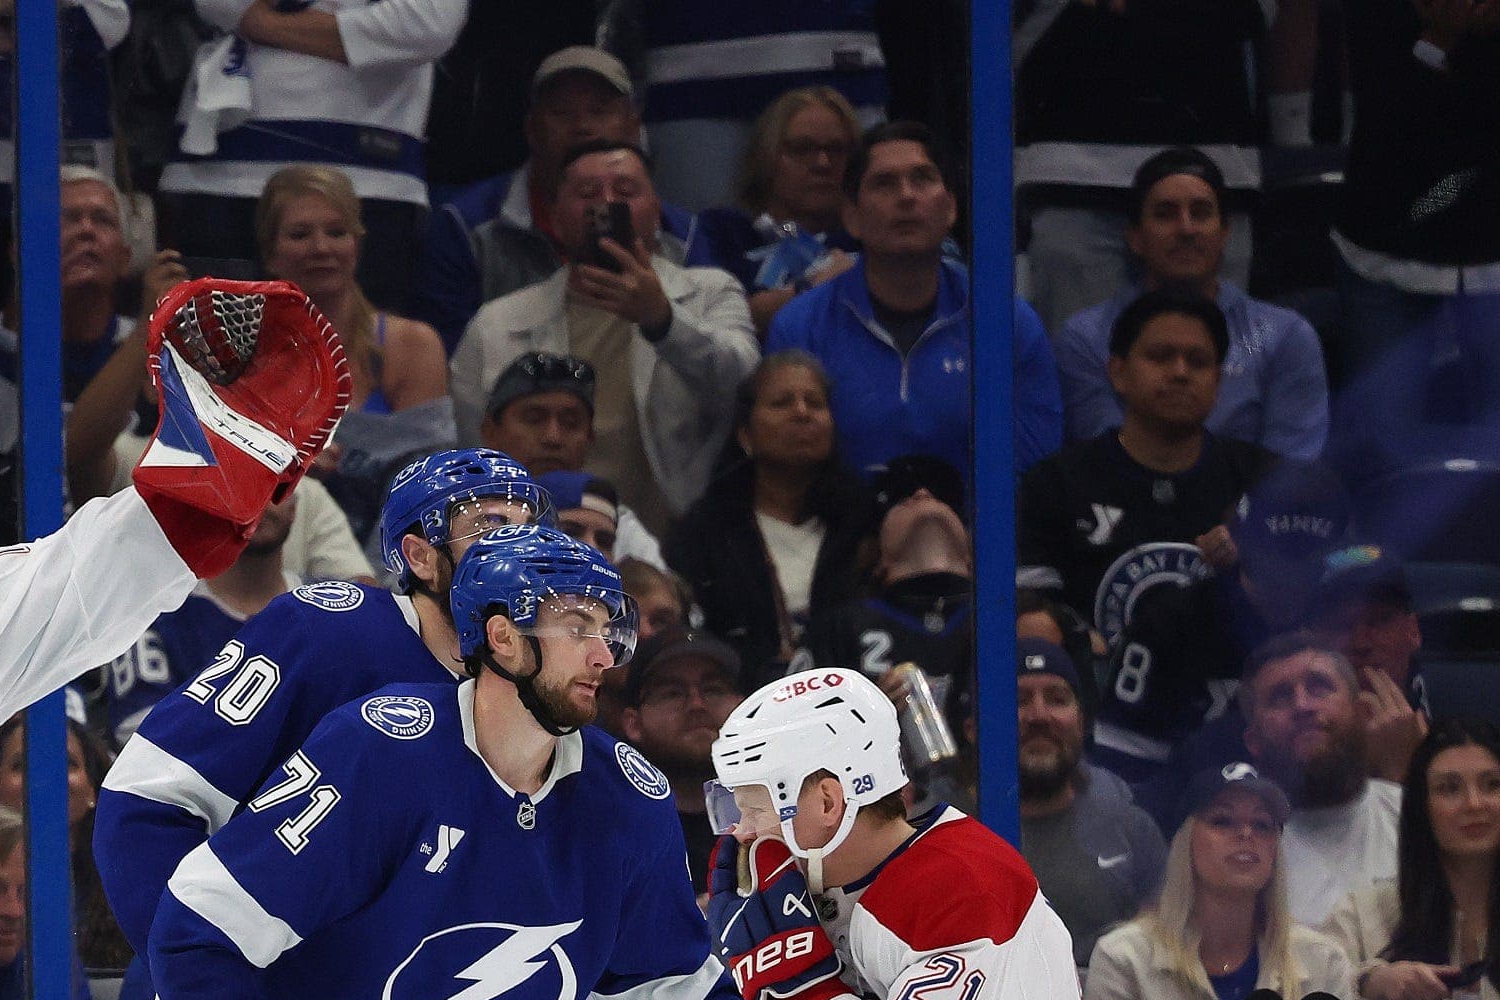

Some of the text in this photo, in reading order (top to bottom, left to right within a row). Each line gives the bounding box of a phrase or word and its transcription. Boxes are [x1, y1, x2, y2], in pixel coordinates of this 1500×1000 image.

[213, 416, 286, 467] TRUE
[110, 629, 171, 697] 86
[181, 638, 282, 726] 20
[772, 676, 822, 702] CIBC
[247, 748, 342, 857] 71
[852, 774, 875, 795] 29
[419, 842, 433, 856] the
[732, 931, 815, 996] BAU
